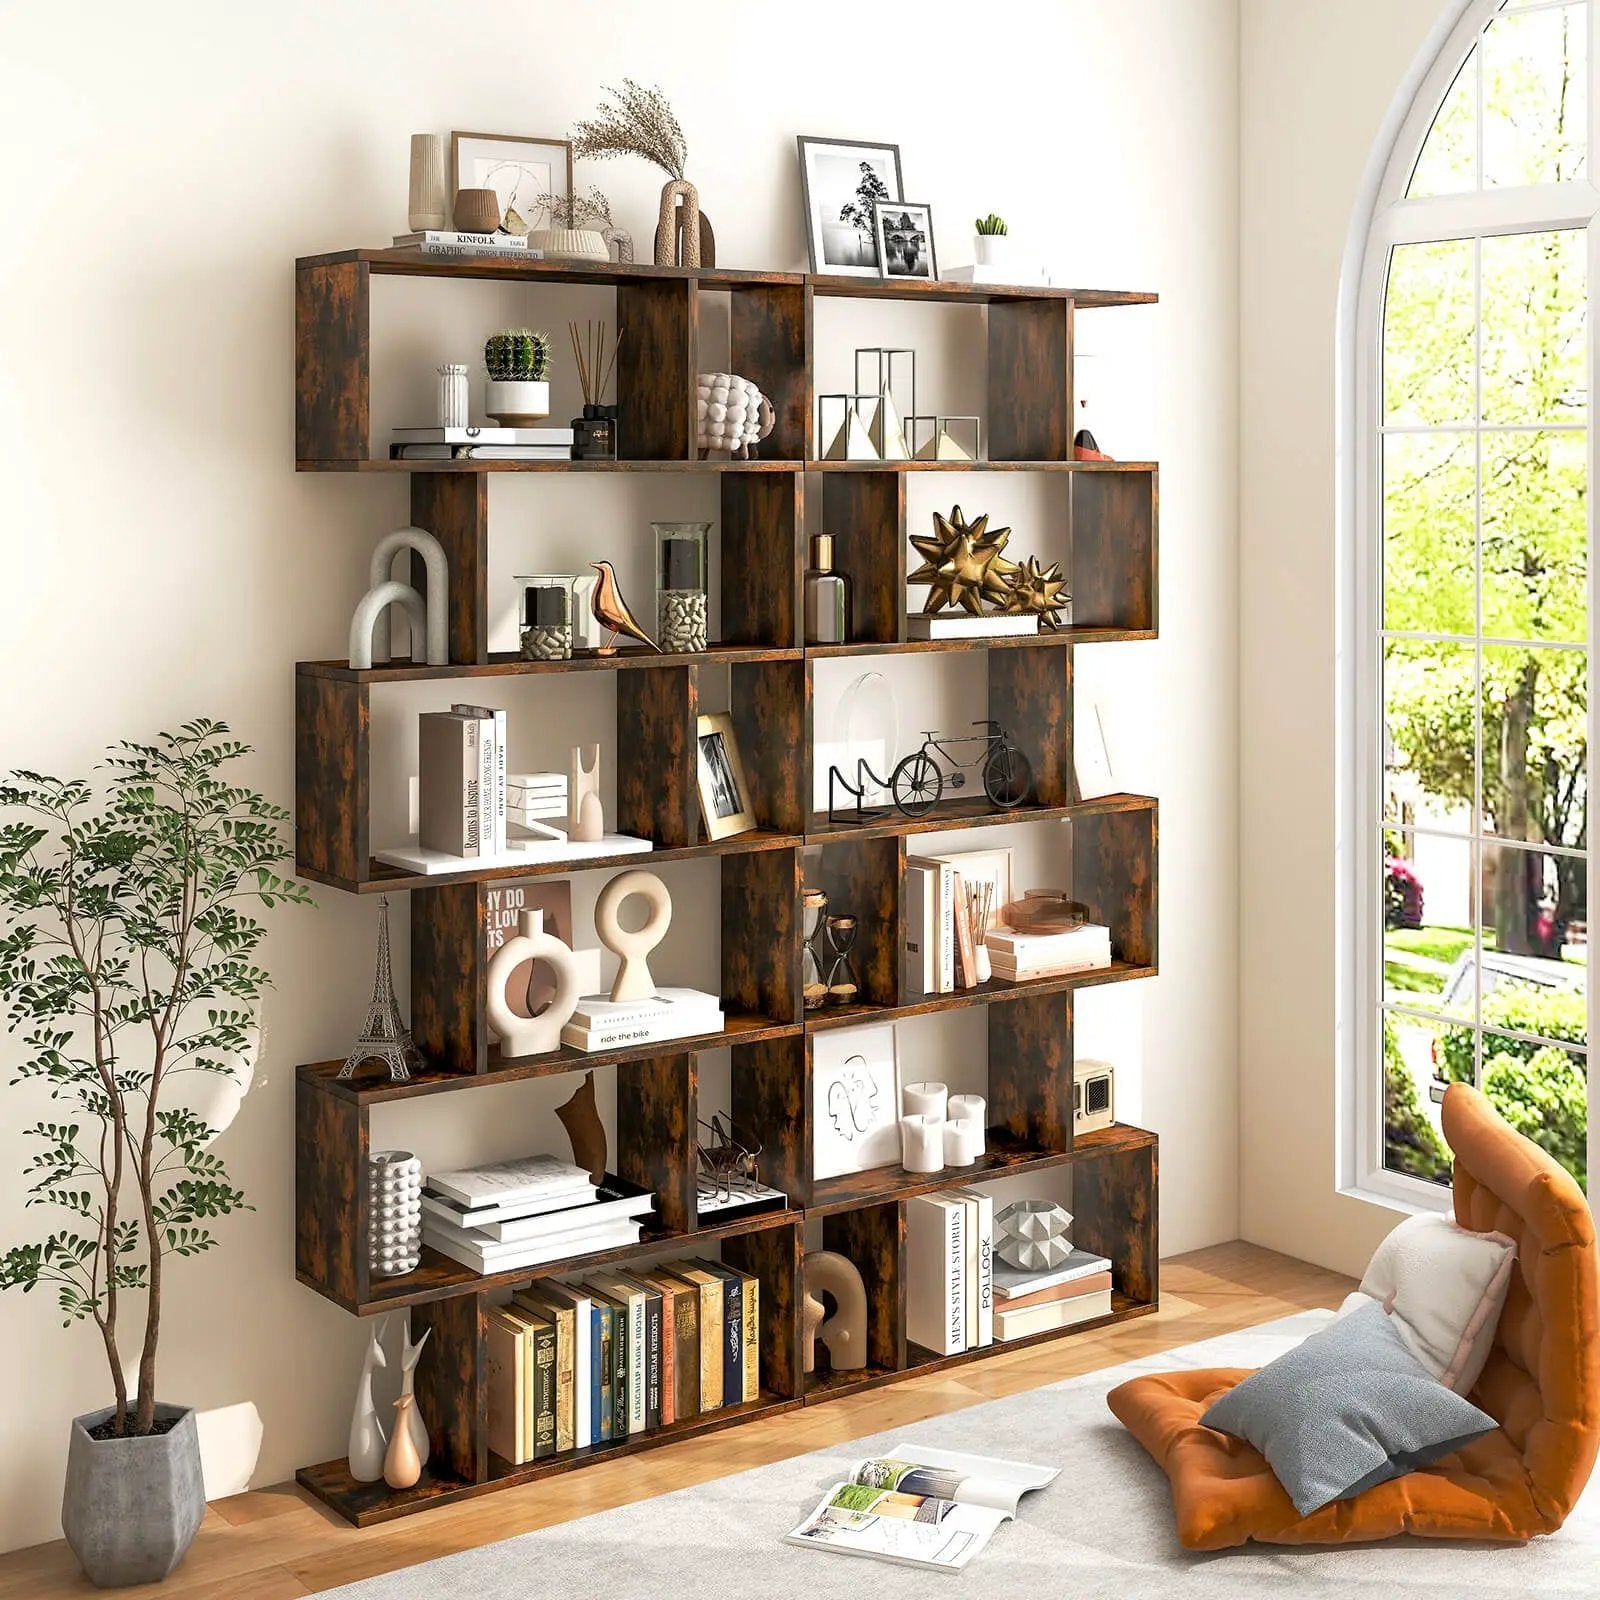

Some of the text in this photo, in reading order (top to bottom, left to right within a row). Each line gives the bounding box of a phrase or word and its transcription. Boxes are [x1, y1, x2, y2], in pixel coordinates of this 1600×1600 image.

[428, 244, 466, 256] GRAPHIC
[456, 233, 496, 245] KINFOLK
[464, 779, 479, 849] Rooms to Inspire
[505, 888, 525, 908] DO
[487, 909, 520, 929] E LOV
[487, 929, 504, 948] TS
[600, 1030, 650, 1043] ride the bike
[951, 1210, 961, 1345] MEN'S STYLE STORIES
[982, 1235, 991, 1309] POLLOCK
[650, 1313, 658, 1352] КРЕПОСТЬ
[634, 1303, 643, 1421] АЛЕКСАНДР БЛОК ПОЭМЫ
[650, 1353, 658, 1385] ЛЕСНАЯ
